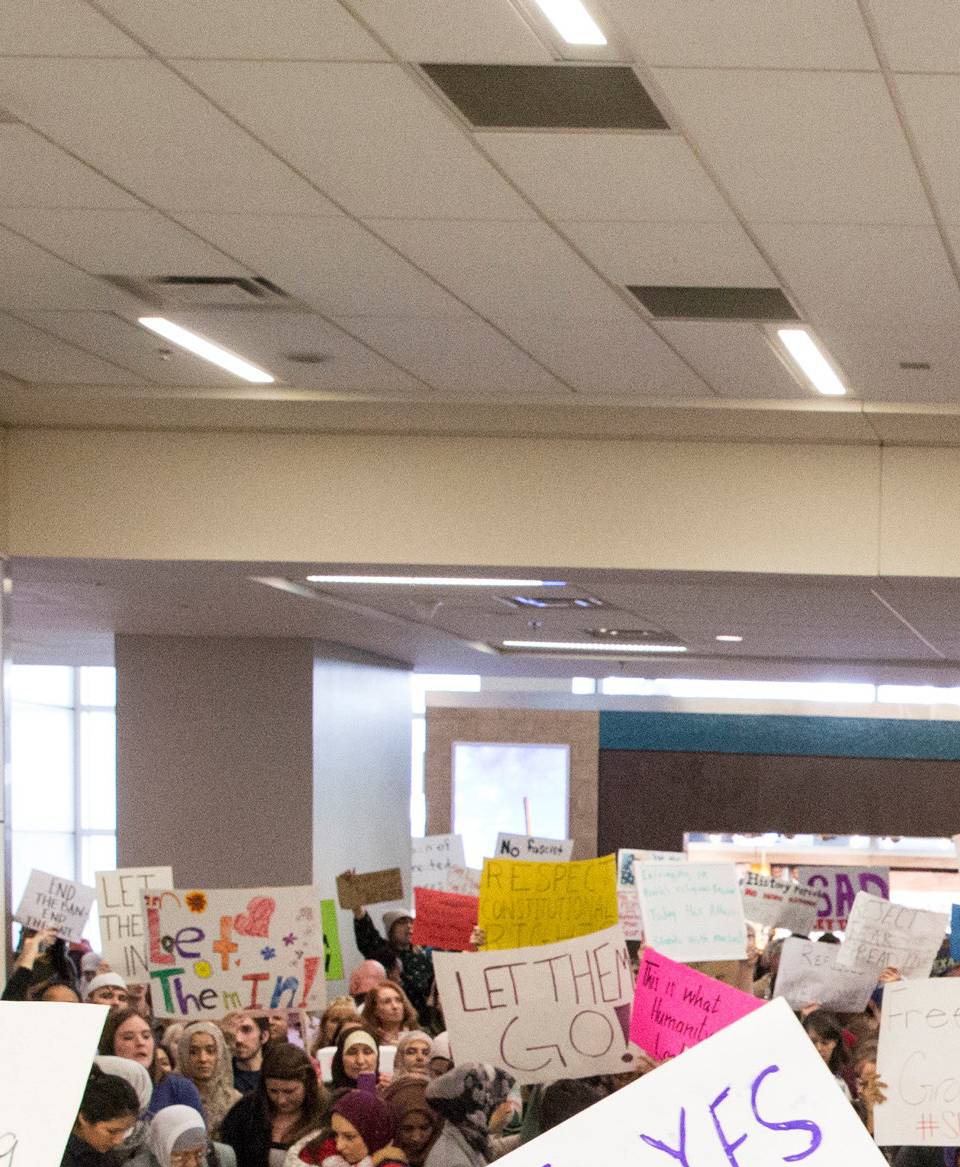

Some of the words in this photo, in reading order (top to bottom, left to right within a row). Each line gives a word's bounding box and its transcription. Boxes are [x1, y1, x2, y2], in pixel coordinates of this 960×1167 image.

[36, 893, 59, 908] THE
[48, 877, 76, 900] END
[101, 874, 155, 909] LET
[42, 908, 66, 924] END
[147, 908, 239, 972] Let
[123, 945, 149, 976] IN
[455, 962, 527, 1012] LET
[533, 942, 634, 1005] THEM
[150, 967, 243, 1015] Them
[683, 985, 721, 1013] what
[500, 1003, 634, 1071] GO!
